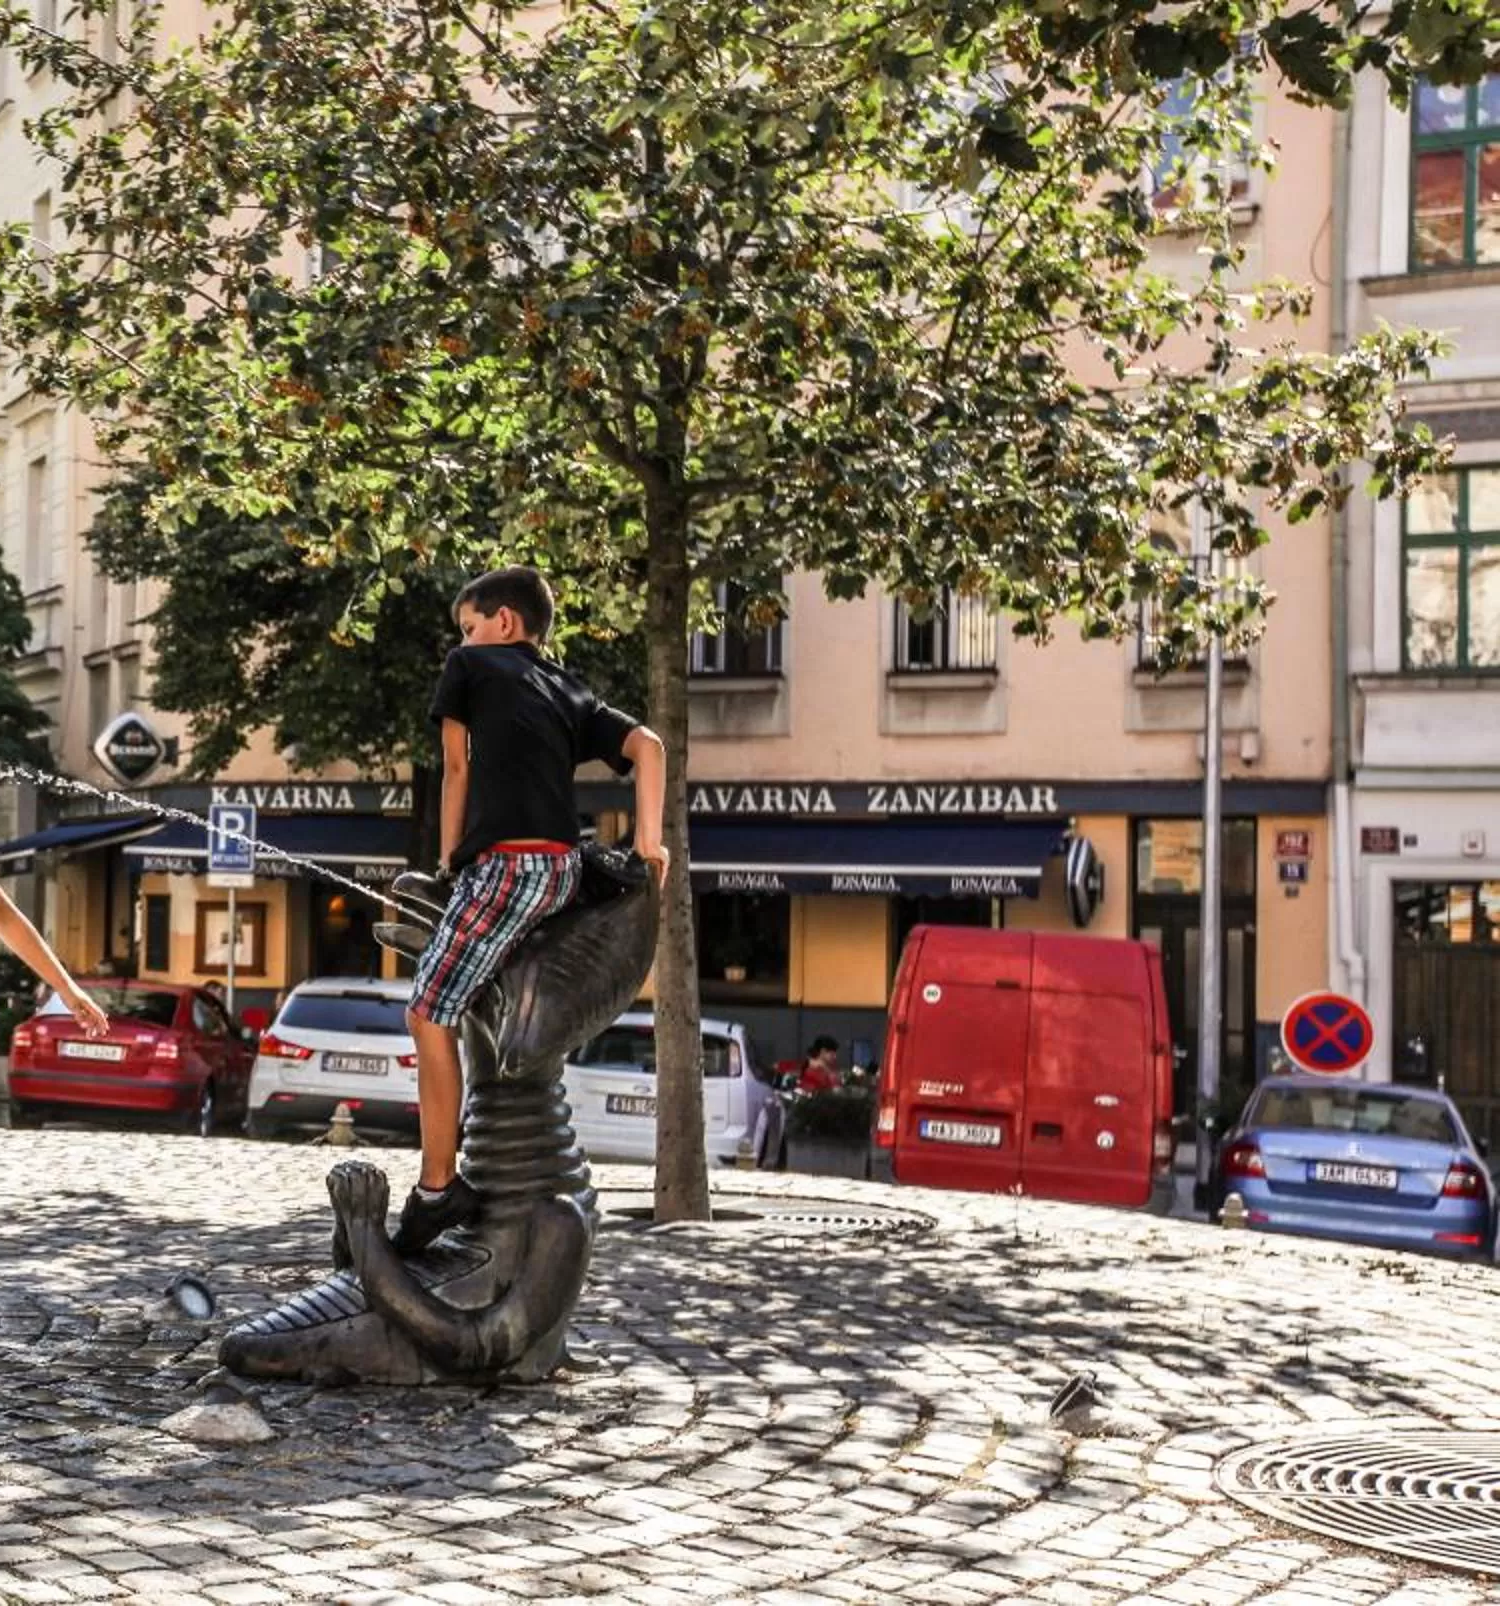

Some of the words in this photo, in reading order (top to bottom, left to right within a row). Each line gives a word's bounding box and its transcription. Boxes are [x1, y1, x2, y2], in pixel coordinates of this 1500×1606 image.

[690, 786, 836, 812] AVÁRNA
[867, 787, 1060, 813] ZANZIBAR
[219, 811, 245, 850] P
